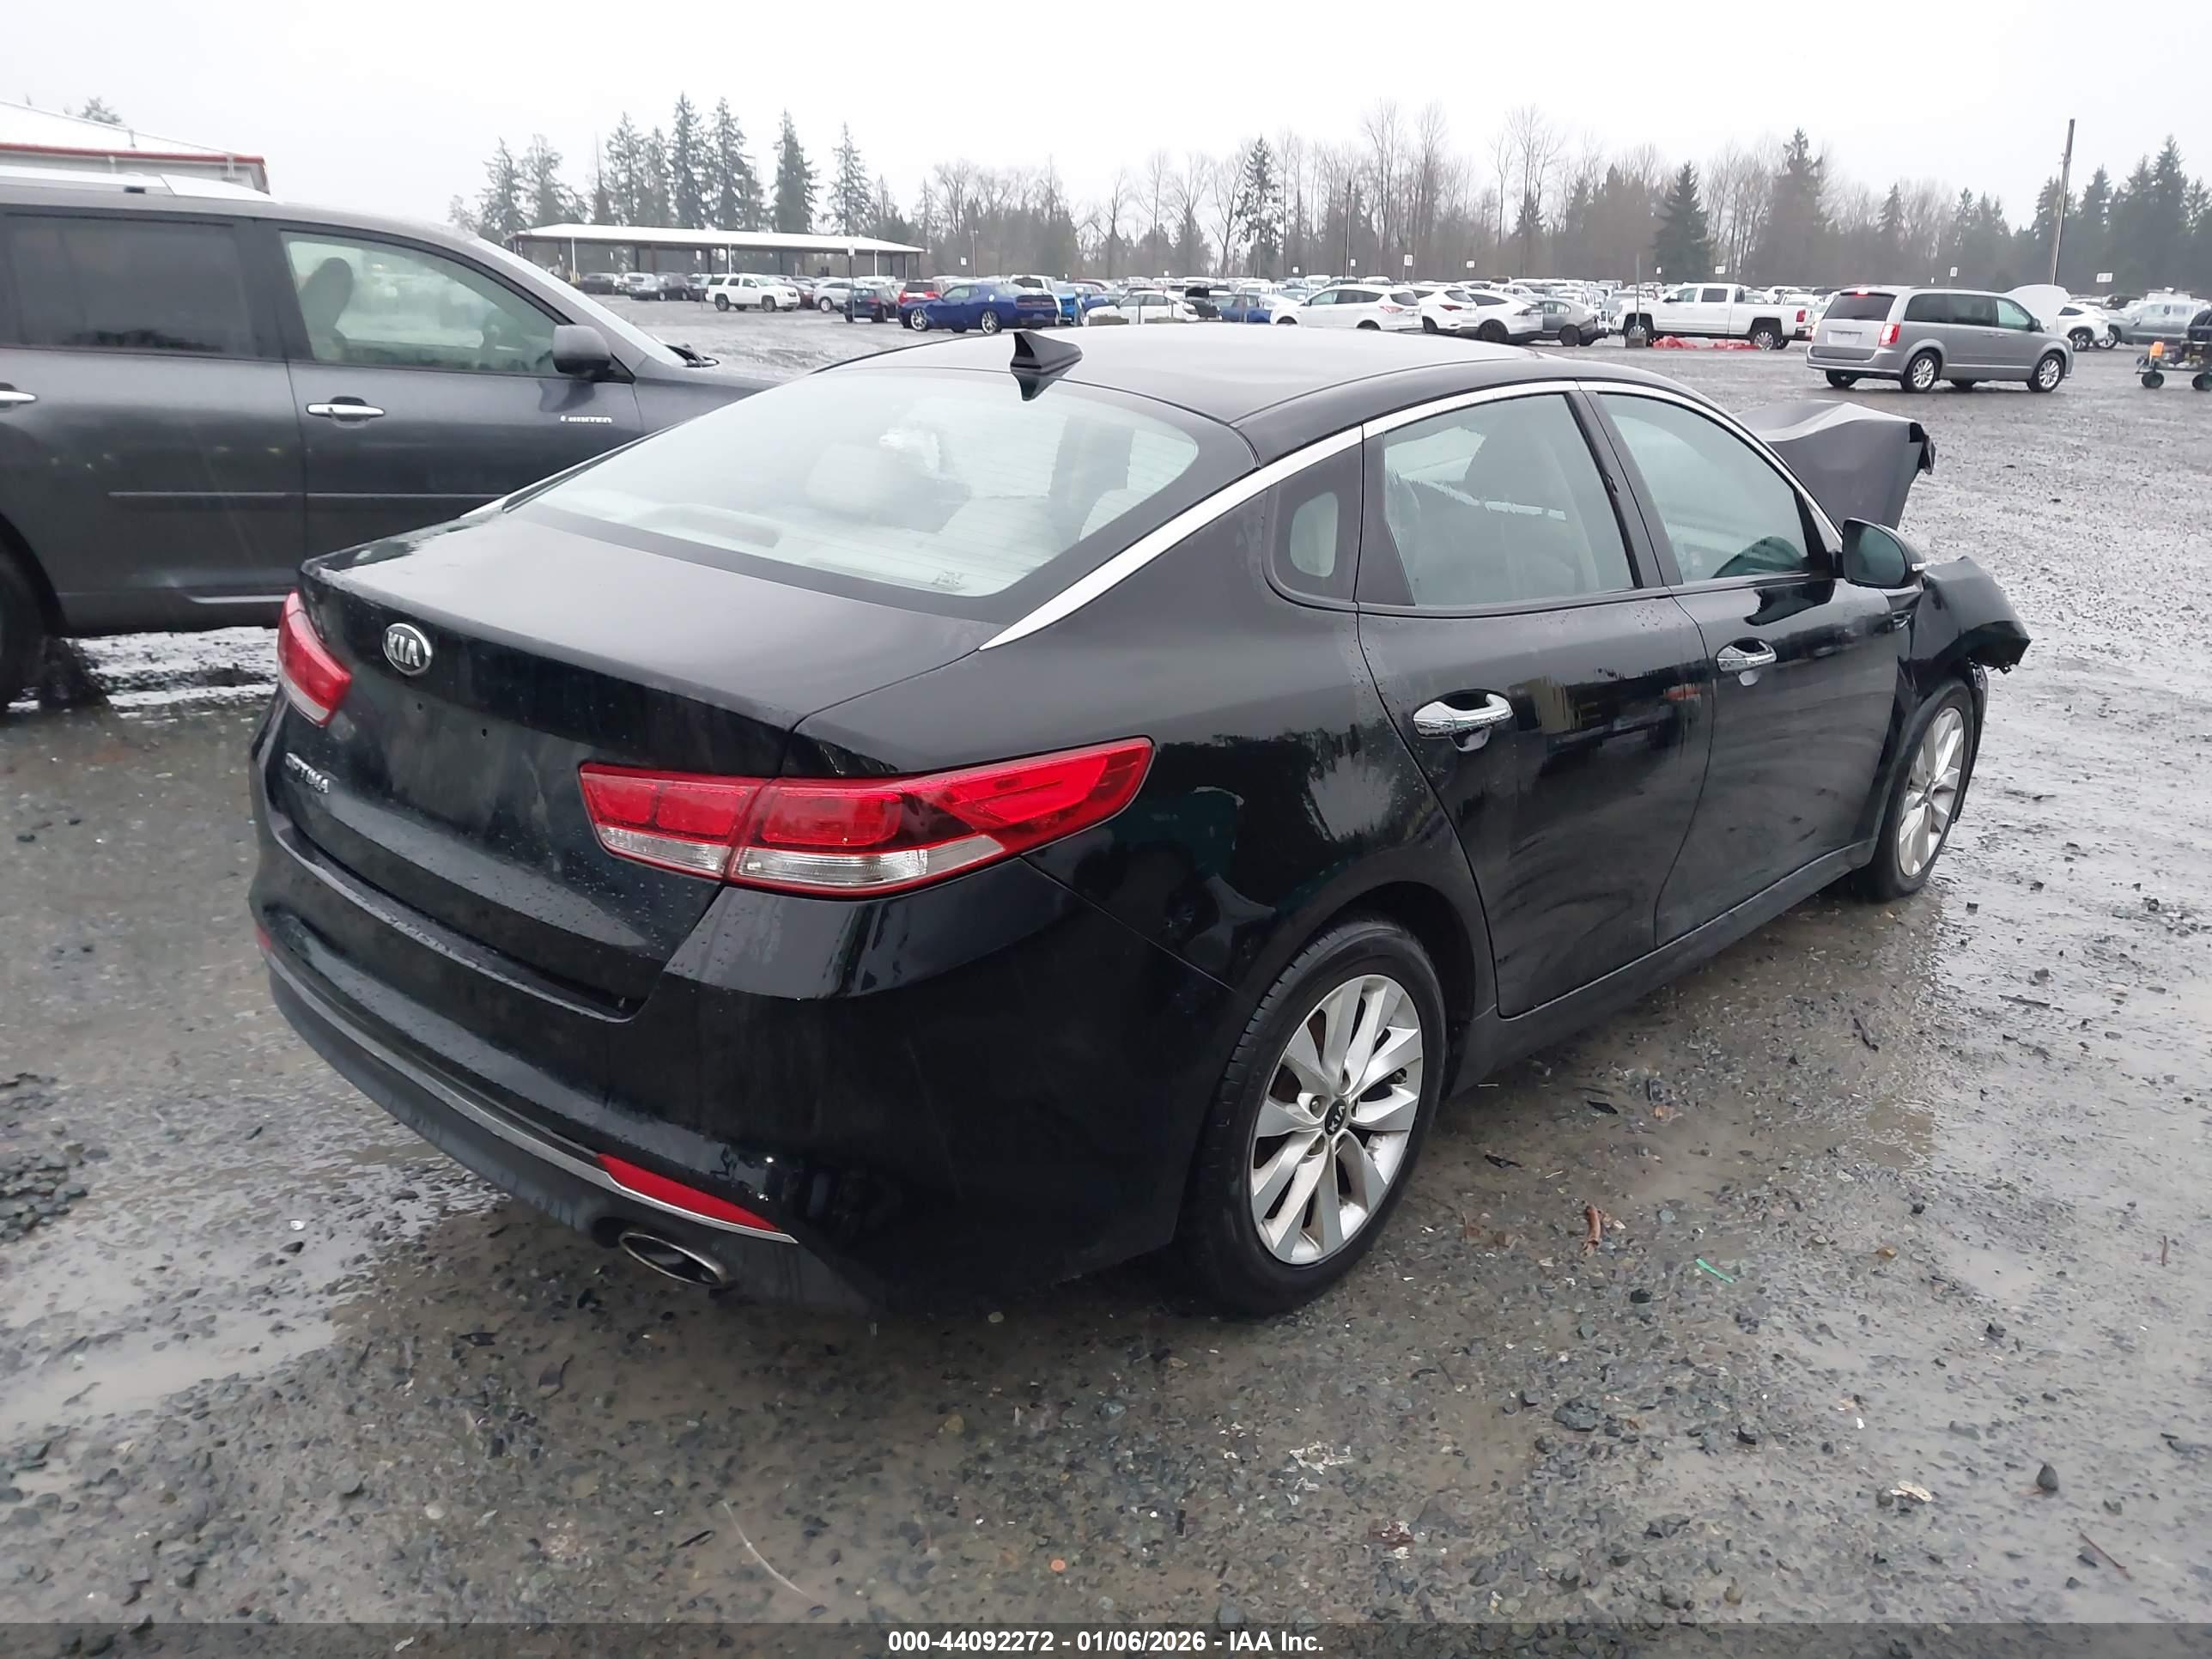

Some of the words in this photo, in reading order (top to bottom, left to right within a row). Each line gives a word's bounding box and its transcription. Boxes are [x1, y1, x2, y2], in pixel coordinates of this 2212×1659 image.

[387, 631, 421, 667] KIA
[285, 752, 330, 793] OPTIMA
[1328, 1105, 1346, 1133] KIA
